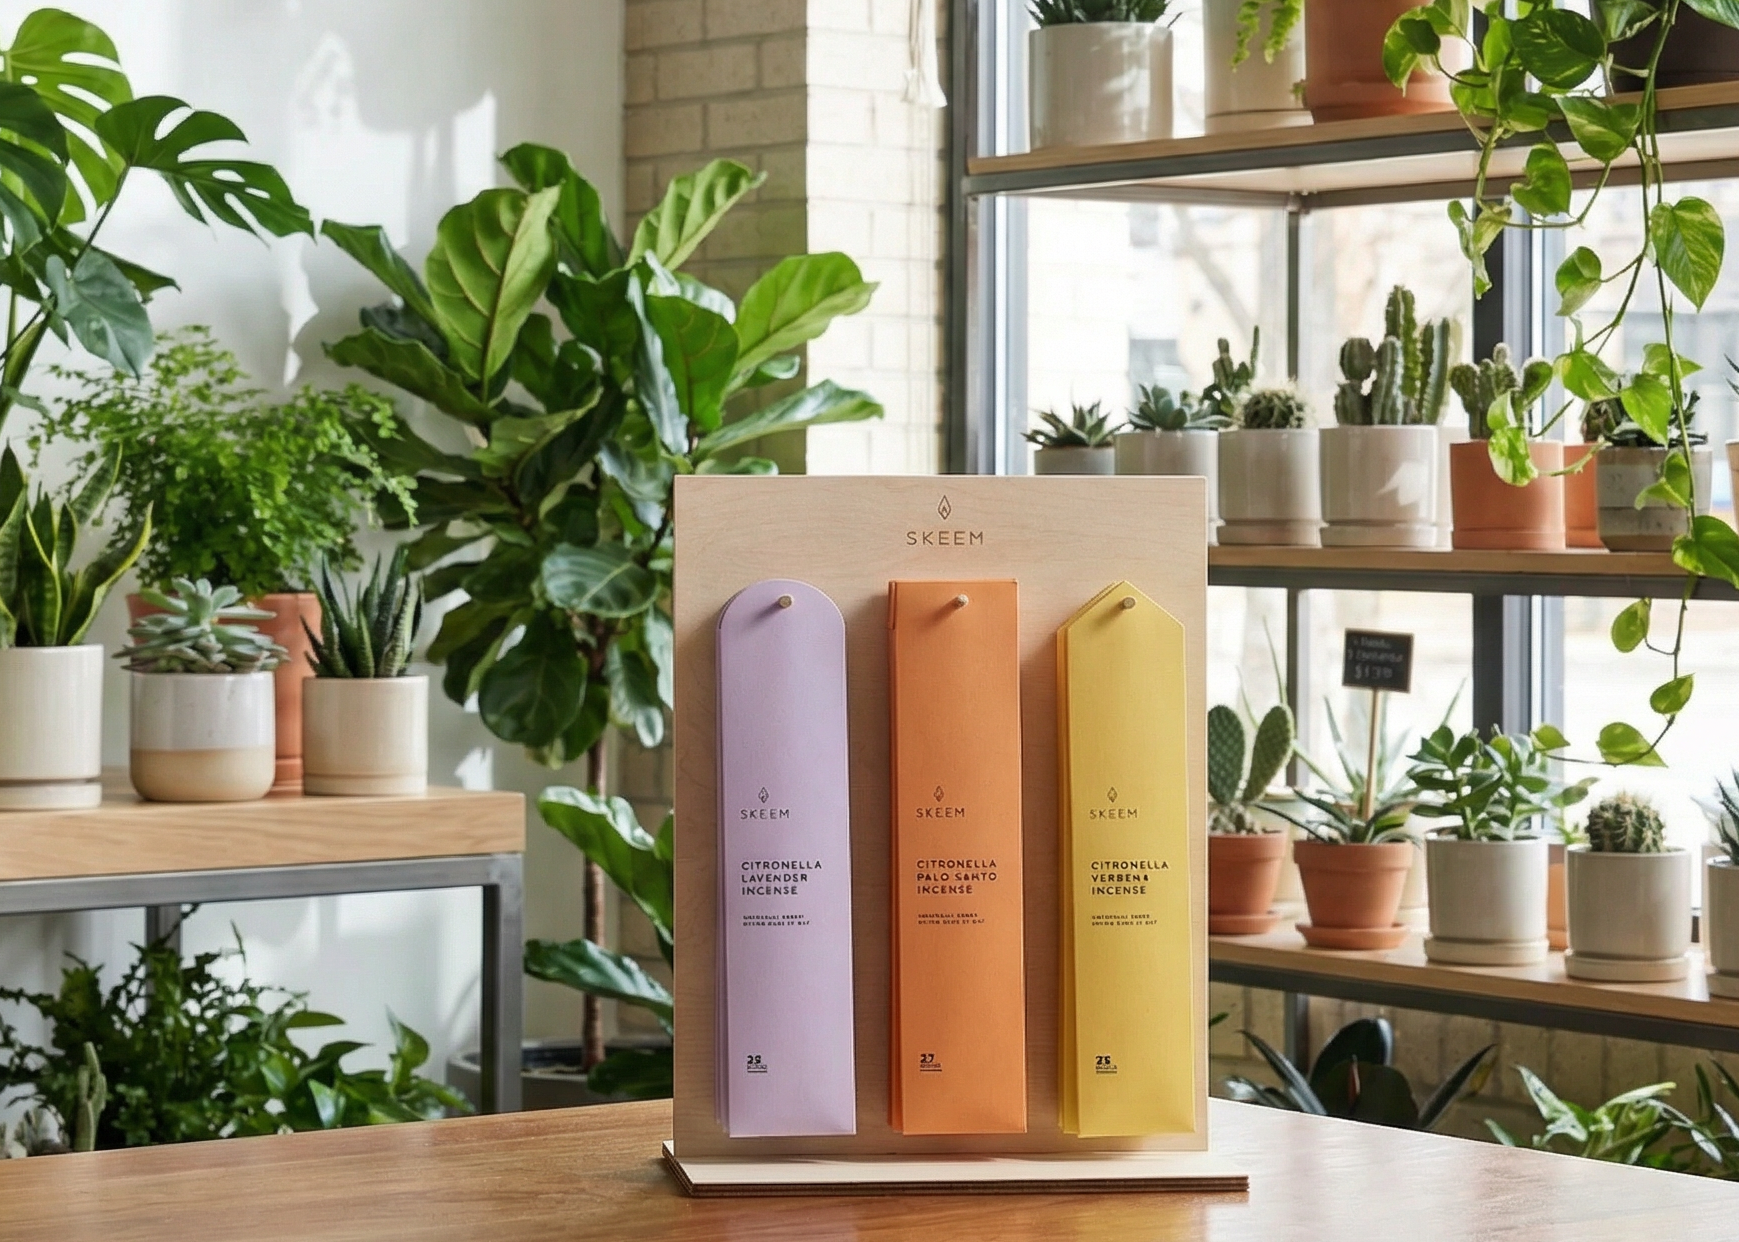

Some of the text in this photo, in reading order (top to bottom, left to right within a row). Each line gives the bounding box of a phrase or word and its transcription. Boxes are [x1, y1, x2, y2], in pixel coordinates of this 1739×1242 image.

[906, 530, 984, 546] SKEEM
[740, 808, 790, 820] SKEEM
[915, 807, 966, 818] SKEEM
[1089, 808, 1139, 820] SKEEM
[741, 860, 822, 871] CITRONELLA
[916, 859, 997, 869] CITRONELLA
[1091, 860, 1169, 870] CITRONELLA
[917, 872, 950, 882] PALO
[741, 886, 799, 896] INCENSE
[917, 885, 973, 894] INCENSE
[1091, 885, 1147, 896] INCENSE
